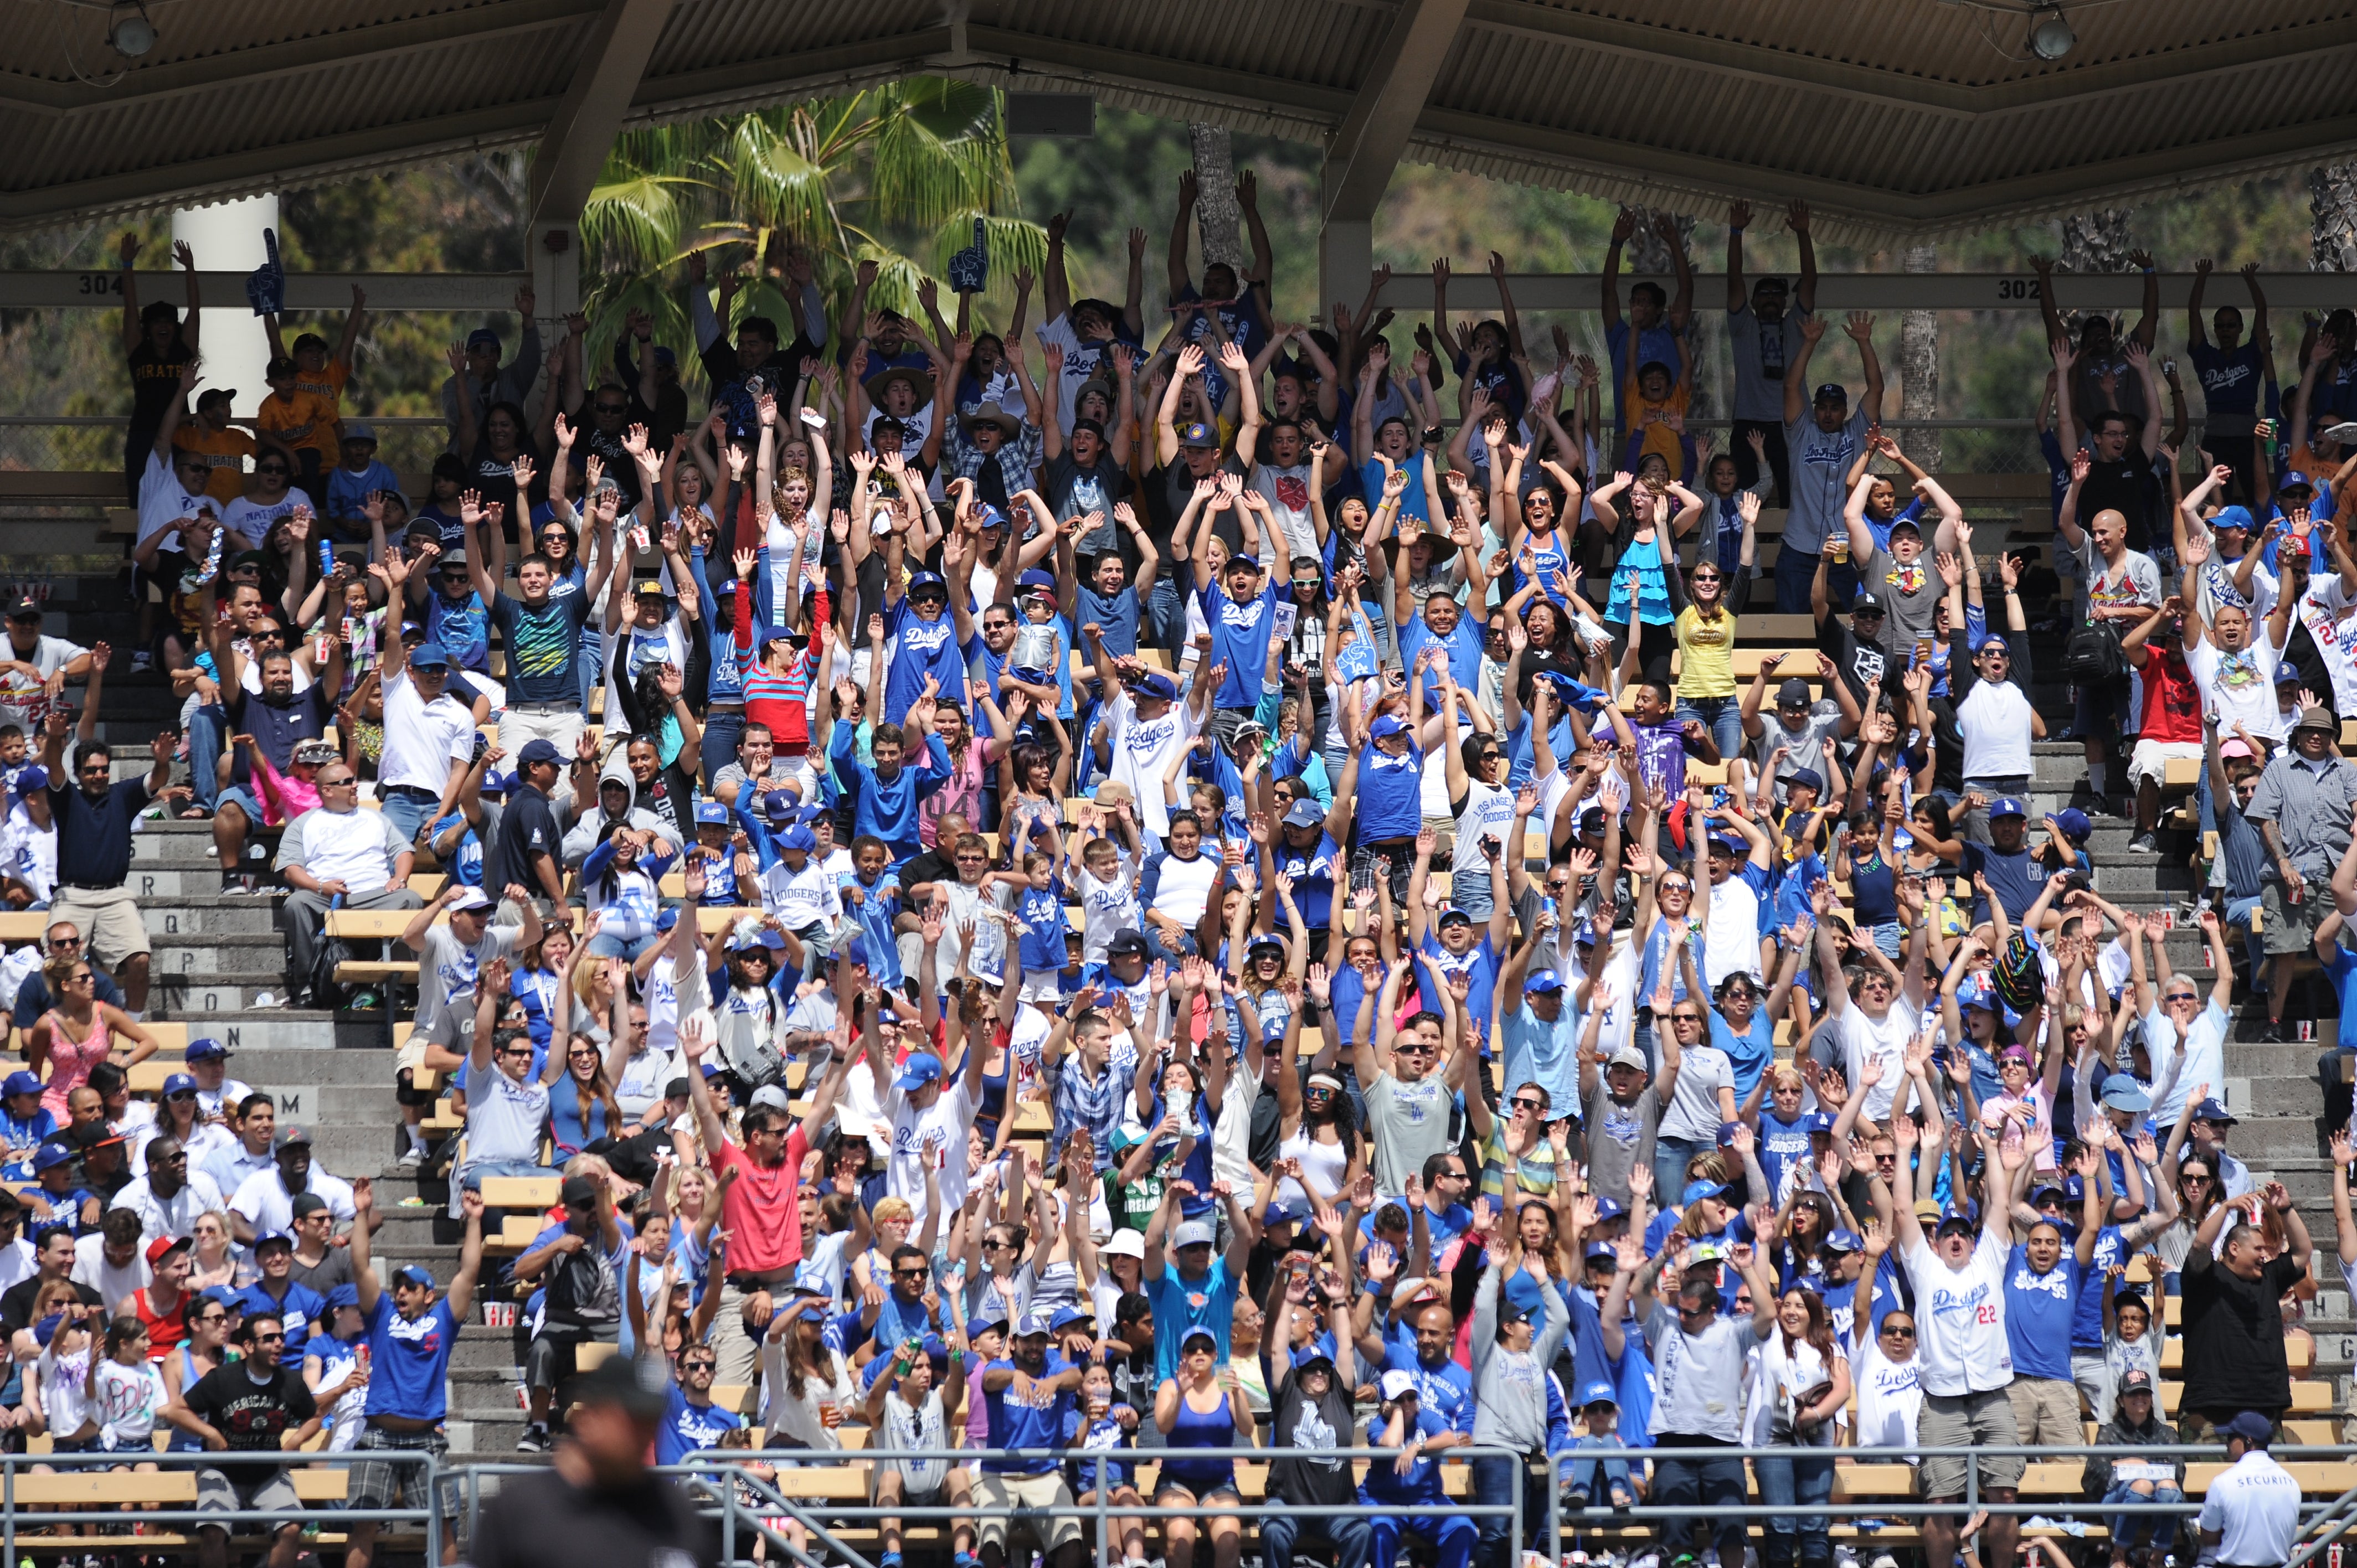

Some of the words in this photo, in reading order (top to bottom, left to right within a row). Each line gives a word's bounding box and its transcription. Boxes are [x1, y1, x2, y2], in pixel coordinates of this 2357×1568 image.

[79, 275, 124, 295] 304
[961, 270, 977, 286] LA
[1998, 279, 2040, 300] 302
[259, 293, 274, 312] LA
[136, 363, 183, 383] PIRATE
[2205, 364, 2250, 390] Dodgers
[737, 426, 745, 436] LA
[245, 503, 295, 522] NATIONA
[2218, 506, 2229, 517] B
[440, 520, 465, 537] Dodge
[727, 580, 735, 590] LA
[924, 572, 934, 581] LA
[548, 582, 576, 598] dgers
[1866, 593, 1875, 604] LA
[1761, 621, 1766, 630] 2
[2307, 612, 2333, 632] dinals
[905, 624, 951, 650] Dodgers
[1029, 630, 1037, 640] LA
[1351, 662, 1368, 675] LA
[0, 692, 51, 708] Cardinal
[596, 697, 604, 705] 16
[1126, 722, 1174, 751] Dodgers
[485, 772, 496, 785] LA
[780, 797, 791, 809] LA
[925, 790, 971, 821] 04
[1474, 801, 1490, 817] LOS
[2004, 799, 2015, 812] LA
[1483, 809, 1514, 823] DODGER
[1533, 842, 1539, 850] 6
[1286, 857, 1328, 881] Dogers
[2026, 862, 2042, 881] GB
[142, 875, 154, 896] R
[775, 888, 821, 903] DODGERS
[166, 915, 178, 935] Q
[374, 920, 382, 929] 19
[1584, 922, 1593, 935] LA
[181, 952, 194, 972] P
[205, 993, 217, 1012] O
[227, 1027, 240, 1046] N
[903, 1062, 912, 1076] LA
[281, 1094, 300, 1114] M
[1411, 1102, 1424, 1121] LA
[2069, 1180, 2079, 1195] LA
[1124, 1196, 1161, 1213] IRELAN
[1189, 1226, 1198, 1237] LA
[2098, 1253, 2115, 1270] 27
[1932, 1282, 1990, 1313] Dodgers
[2050, 1282, 2067, 1299] 99
[1977, 1305, 1998, 1325] 22
[2312, 1298, 2326, 1317] H
[2341, 1338, 2355, 1360] G
[1422, 1372, 1460, 1399] ANGELES
[1795, 1370, 1806, 1385] 16
[1876, 1369, 1919, 1391] Dodg
[91, 1481, 98, 1490] 4
[790, 1479, 799, 1488] 17
[2236, 1475, 2294, 1488] SECURITY
